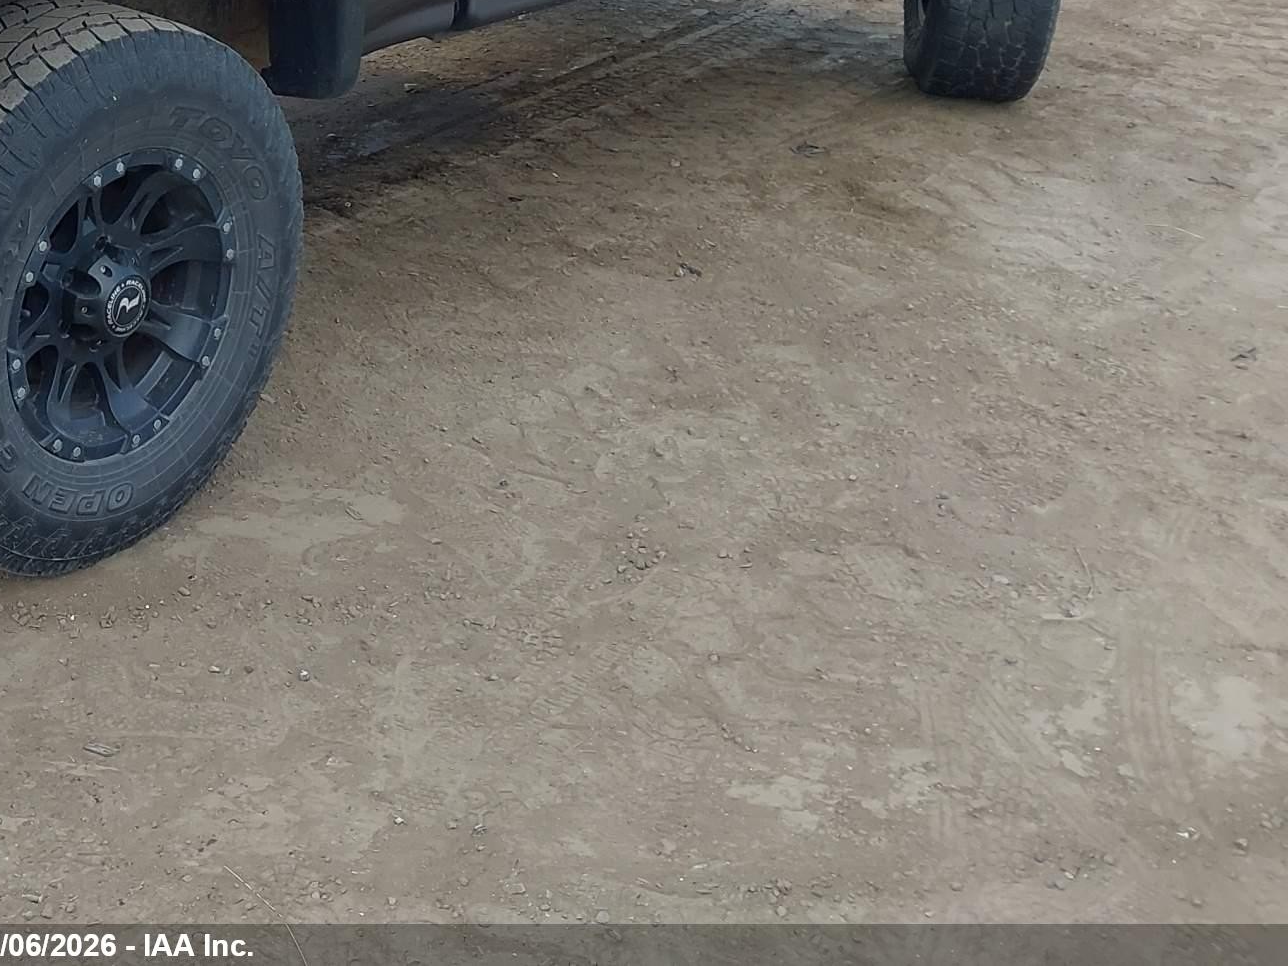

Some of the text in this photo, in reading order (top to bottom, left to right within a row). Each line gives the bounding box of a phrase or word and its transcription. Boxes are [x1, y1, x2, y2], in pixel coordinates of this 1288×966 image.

[169, 106, 270, 201] TOYO
[107, 286, 122, 325] RACELINE
[21, 475, 134, 516] OPEN
